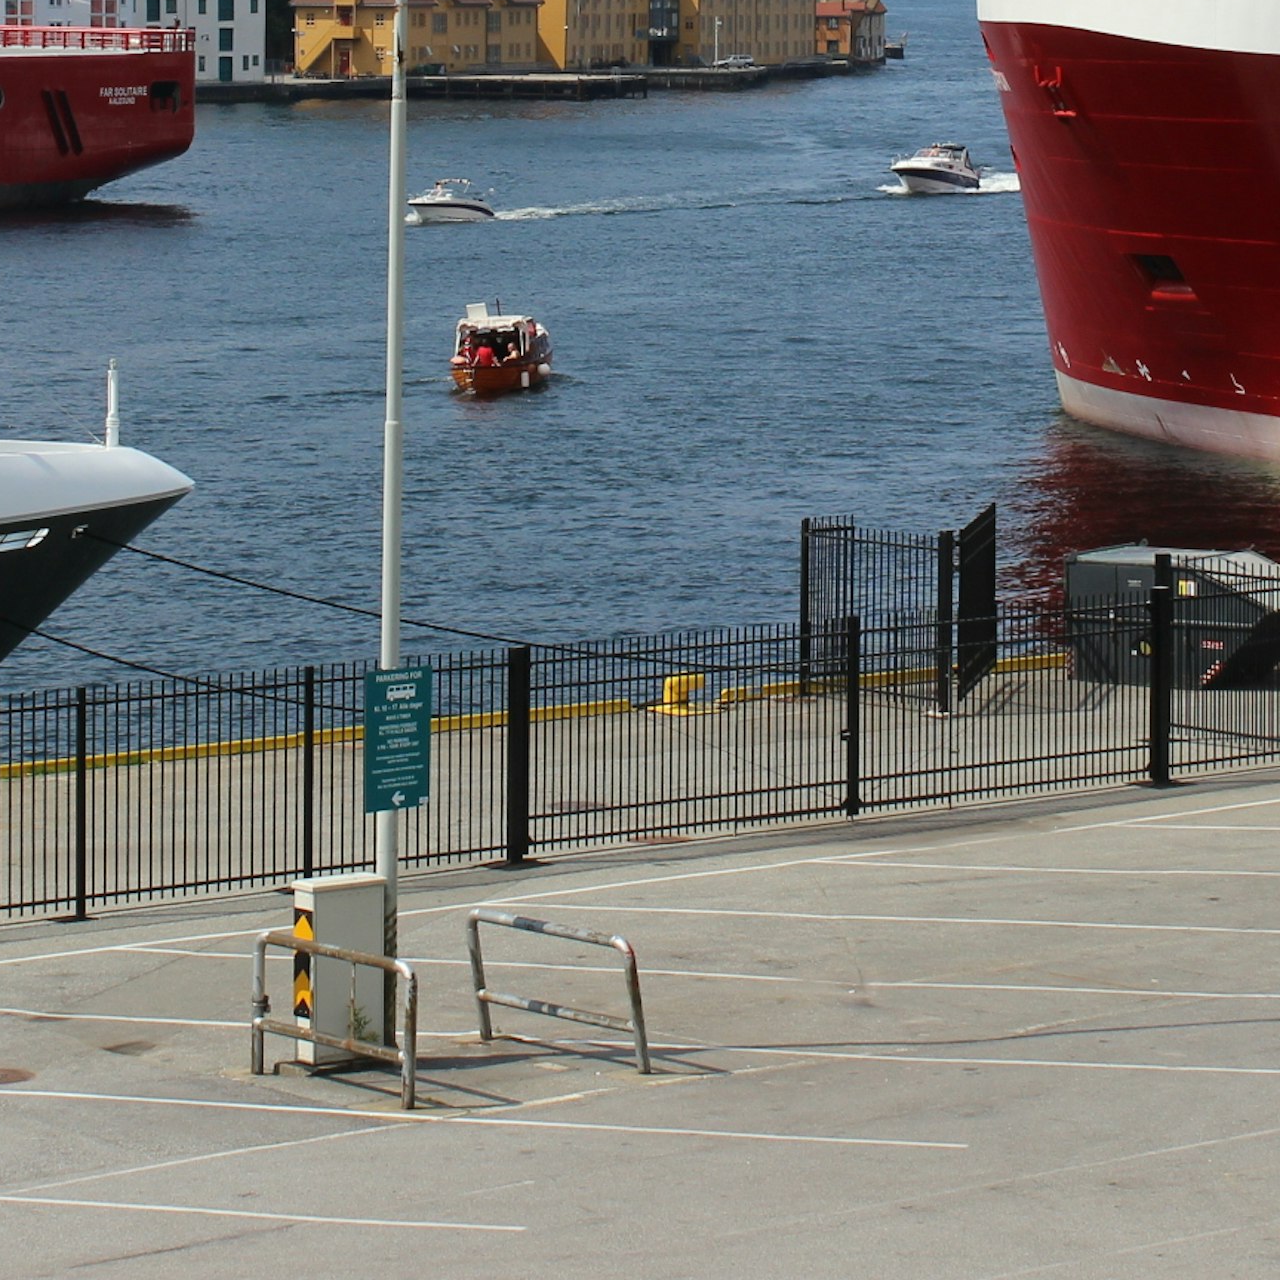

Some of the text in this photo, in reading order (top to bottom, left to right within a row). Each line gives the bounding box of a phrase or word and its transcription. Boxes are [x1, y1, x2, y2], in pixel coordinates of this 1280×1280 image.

[100, 86, 147, 97] FAR SOLITAIRE
[375, 670, 423, 683] PARKERING FOR
